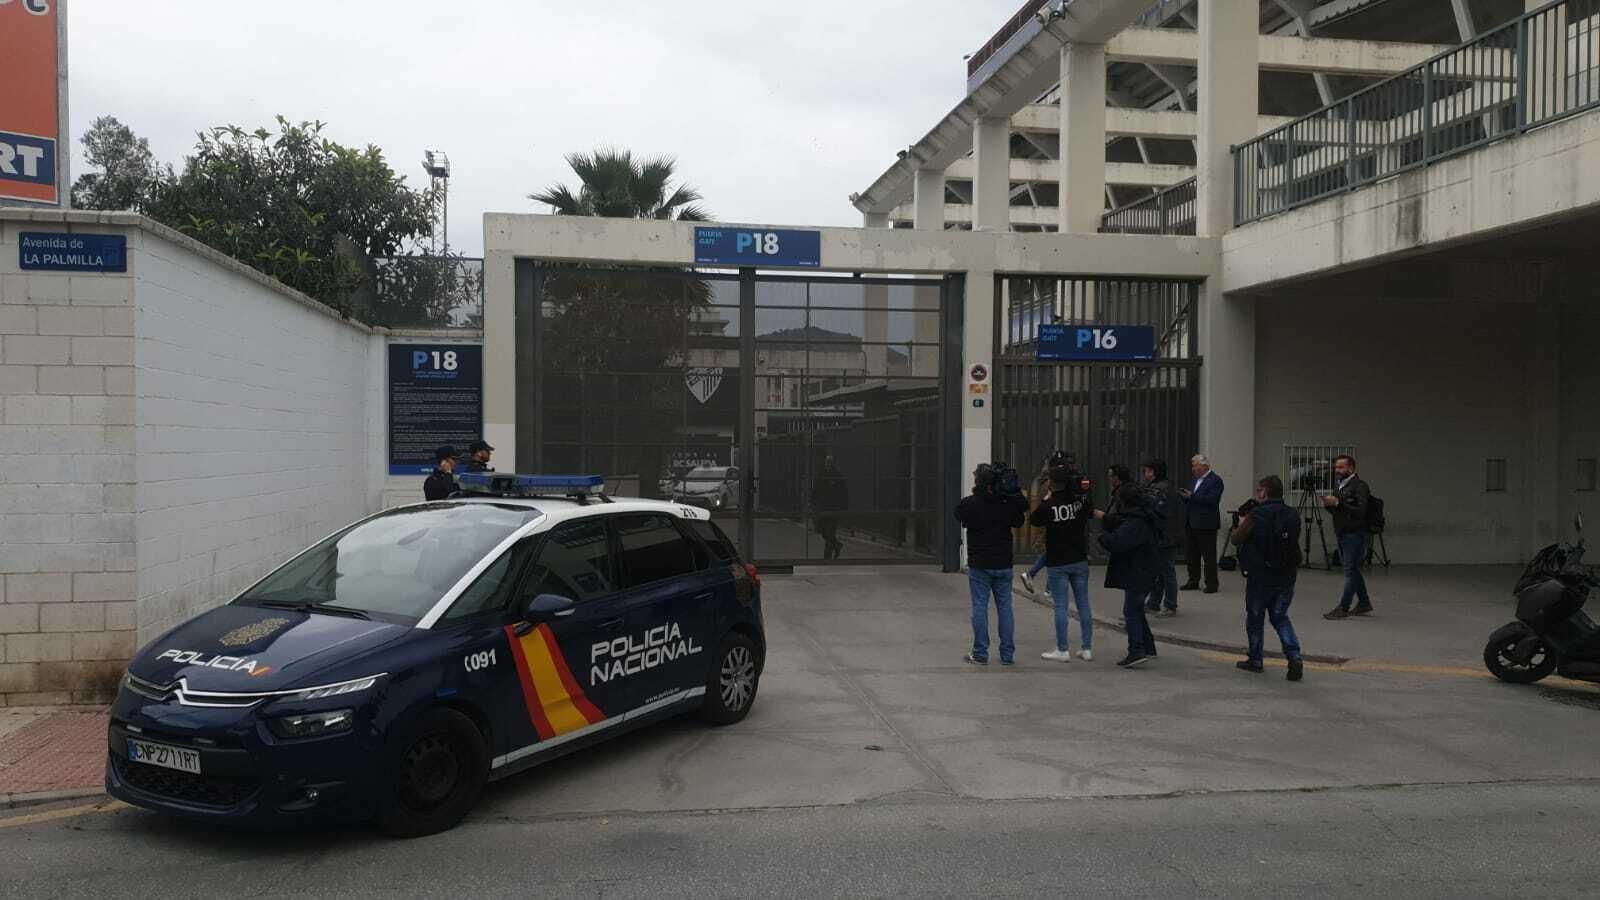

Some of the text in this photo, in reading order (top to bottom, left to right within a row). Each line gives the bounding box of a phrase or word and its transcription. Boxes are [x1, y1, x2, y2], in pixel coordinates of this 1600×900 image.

[22, 237, 84, 249] Avenida de
[736, 232, 780, 255] P18
[24, 253, 104, 266] LA PALMILLA
[1076, 329, 1118, 350] P16
[412, 350, 459, 371] P18
[591, 622, 681, 663] POLICÍA
[470, 648, 497, 671] 091
[590, 637, 703, 687] NACIONAL
